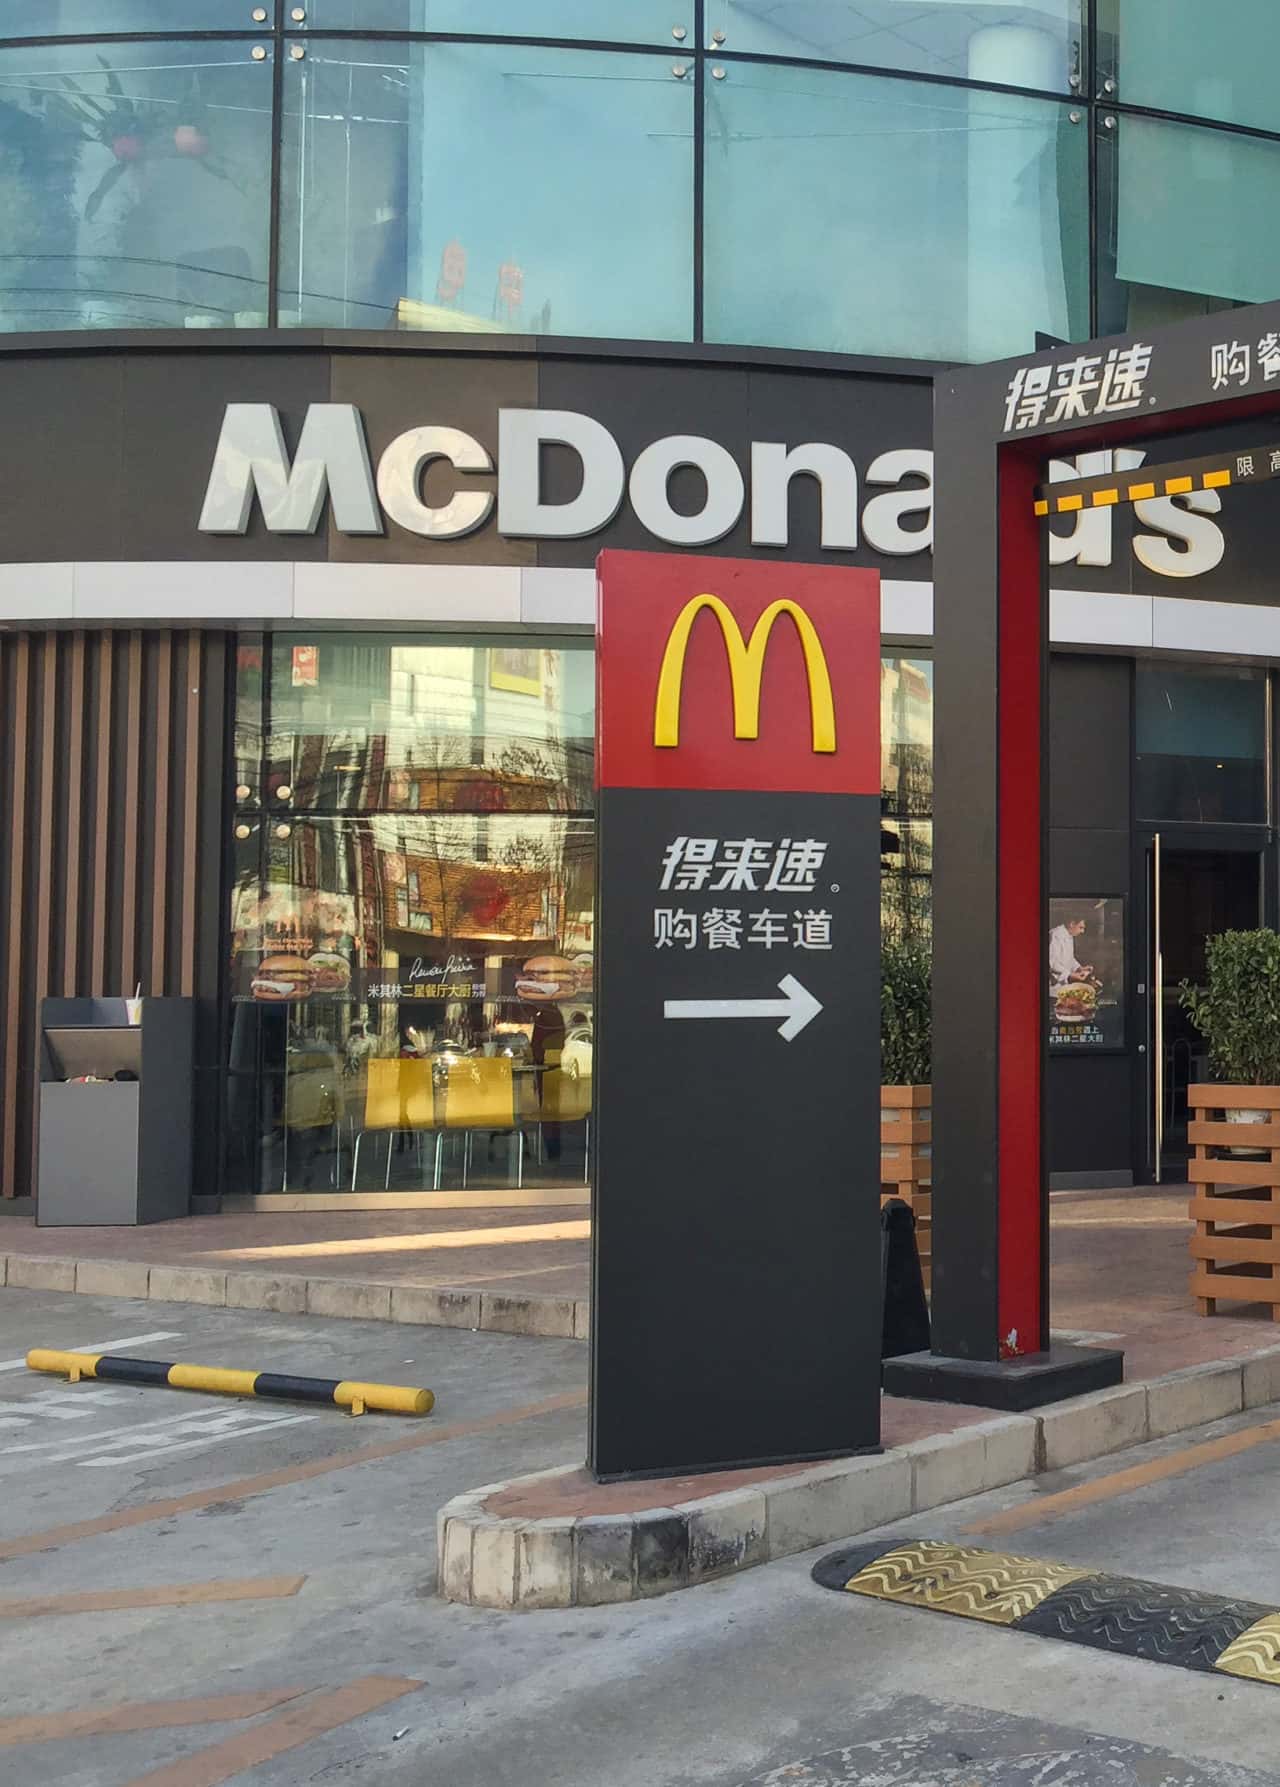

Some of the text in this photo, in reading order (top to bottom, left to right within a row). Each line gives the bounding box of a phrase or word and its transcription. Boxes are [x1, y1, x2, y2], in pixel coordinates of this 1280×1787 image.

[1003, 343, 1152, 432] 得来速
[199, 402, 1225, 578] McDonad's
[659, 836, 828, 892] 得来速
[654, 907, 833, 950] 购餐车道
